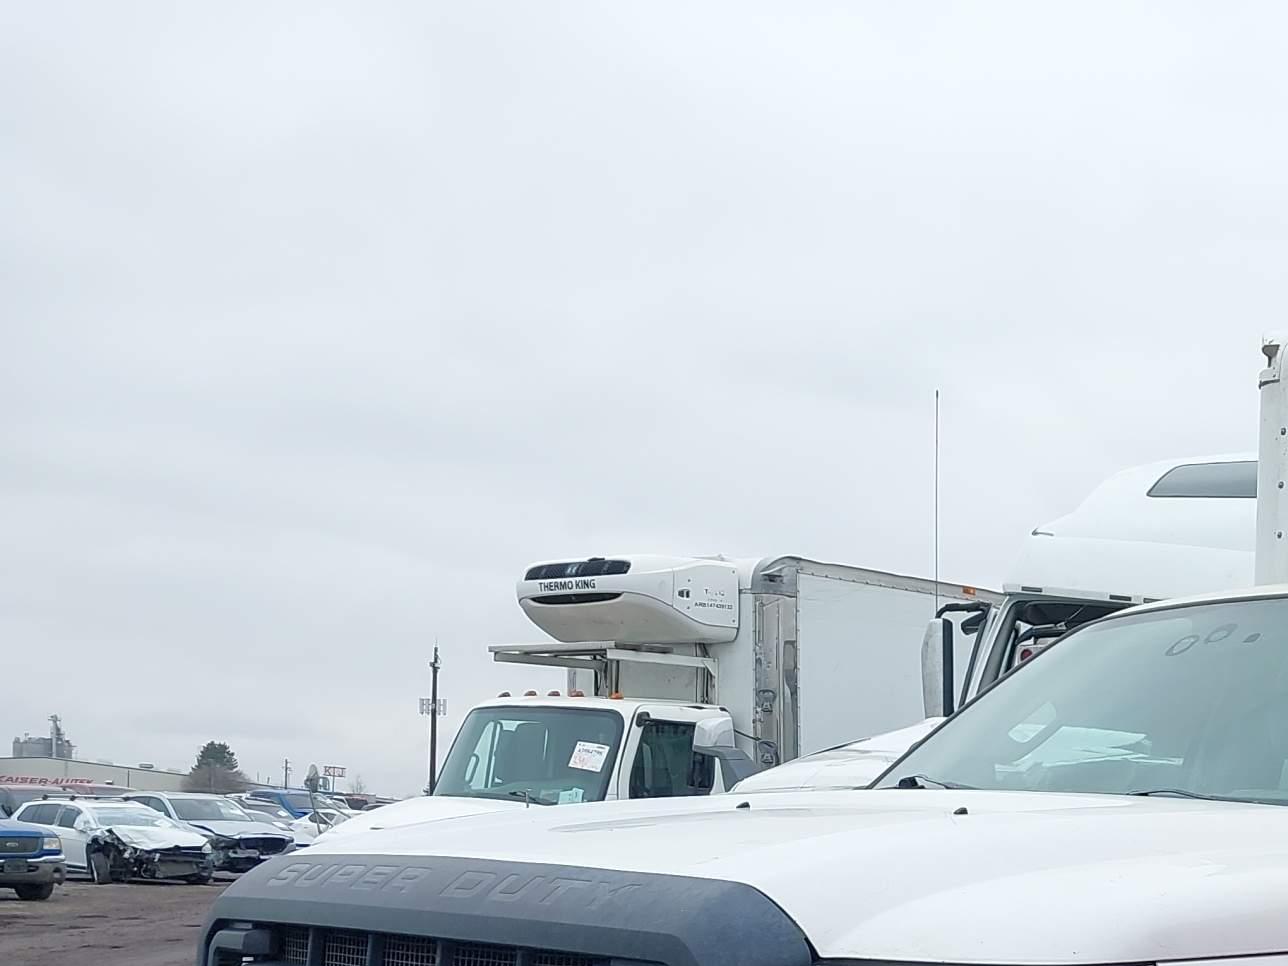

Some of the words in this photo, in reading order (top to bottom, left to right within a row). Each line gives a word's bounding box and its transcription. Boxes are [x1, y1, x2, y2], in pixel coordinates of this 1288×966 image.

[538, 581, 574, 592] THERMO
[575, 579, 597, 590] KING
[268, 863, 432, 893] SUPER
[440, 870, 642, 910] DUTY
